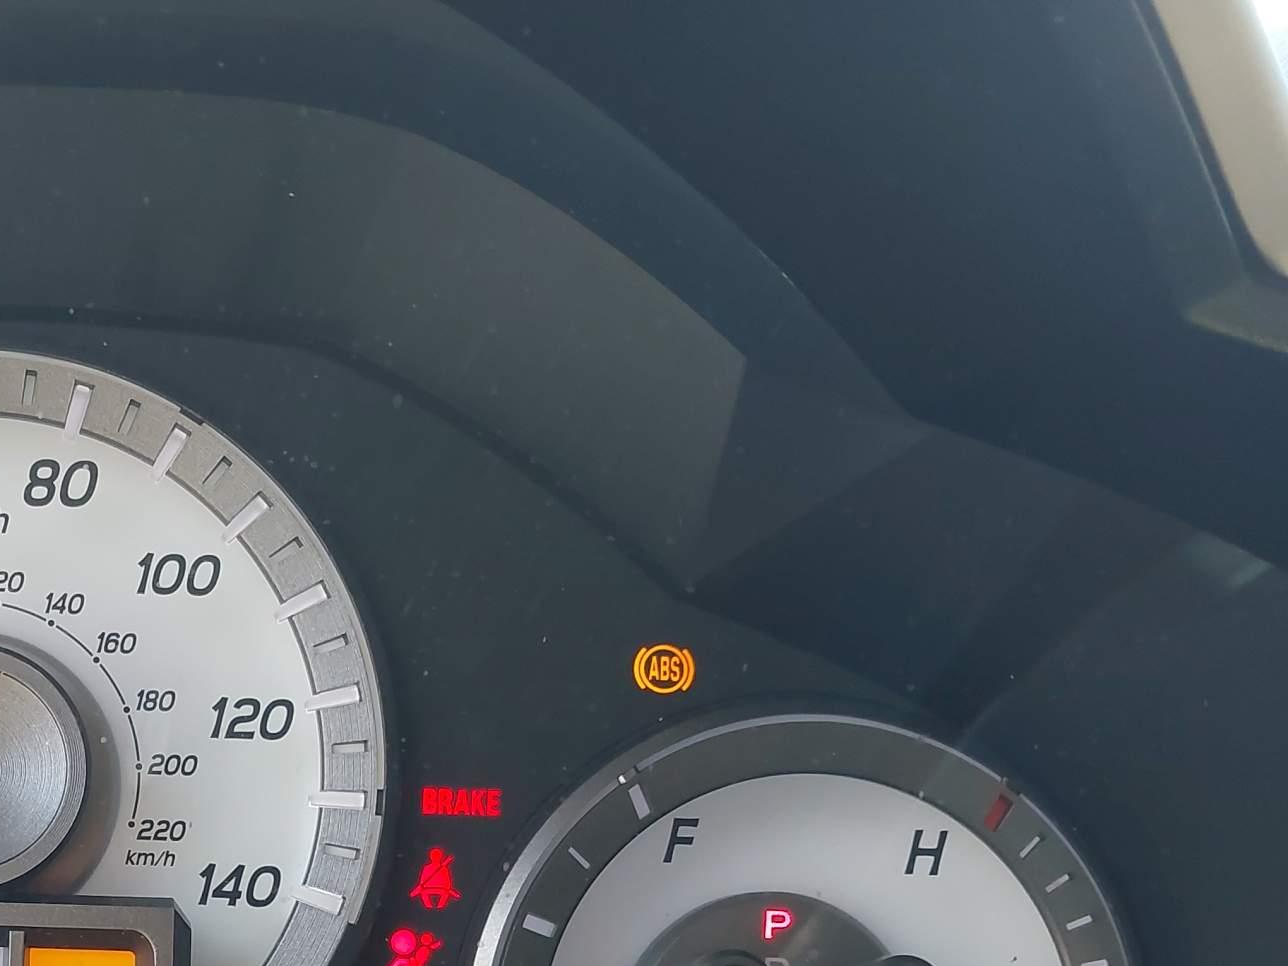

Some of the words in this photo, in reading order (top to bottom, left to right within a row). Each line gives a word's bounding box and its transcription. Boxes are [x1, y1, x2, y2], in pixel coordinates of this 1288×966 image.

[23, 458, 99, 508] 80
[136, 552, 222, 597] 100
[45, 592, 85, 615] 140
[96, 631, 137, 654] 160
[649, 655, 681, 683] ABS
[136, 689, 176, 712] 180
[210, 696, 295, 741] 120
[147, 754, 198, 776] 200
[421, 787, 502, 818] BRAKE
[136, 819, 183, 842] 220
[663, 818, 699, 863] F
[124, 849, 176, 868] km/h
[904, 829, 949, 876] H
[198, 863, 281, 908] 140
[763, 909, 792, 939] P
